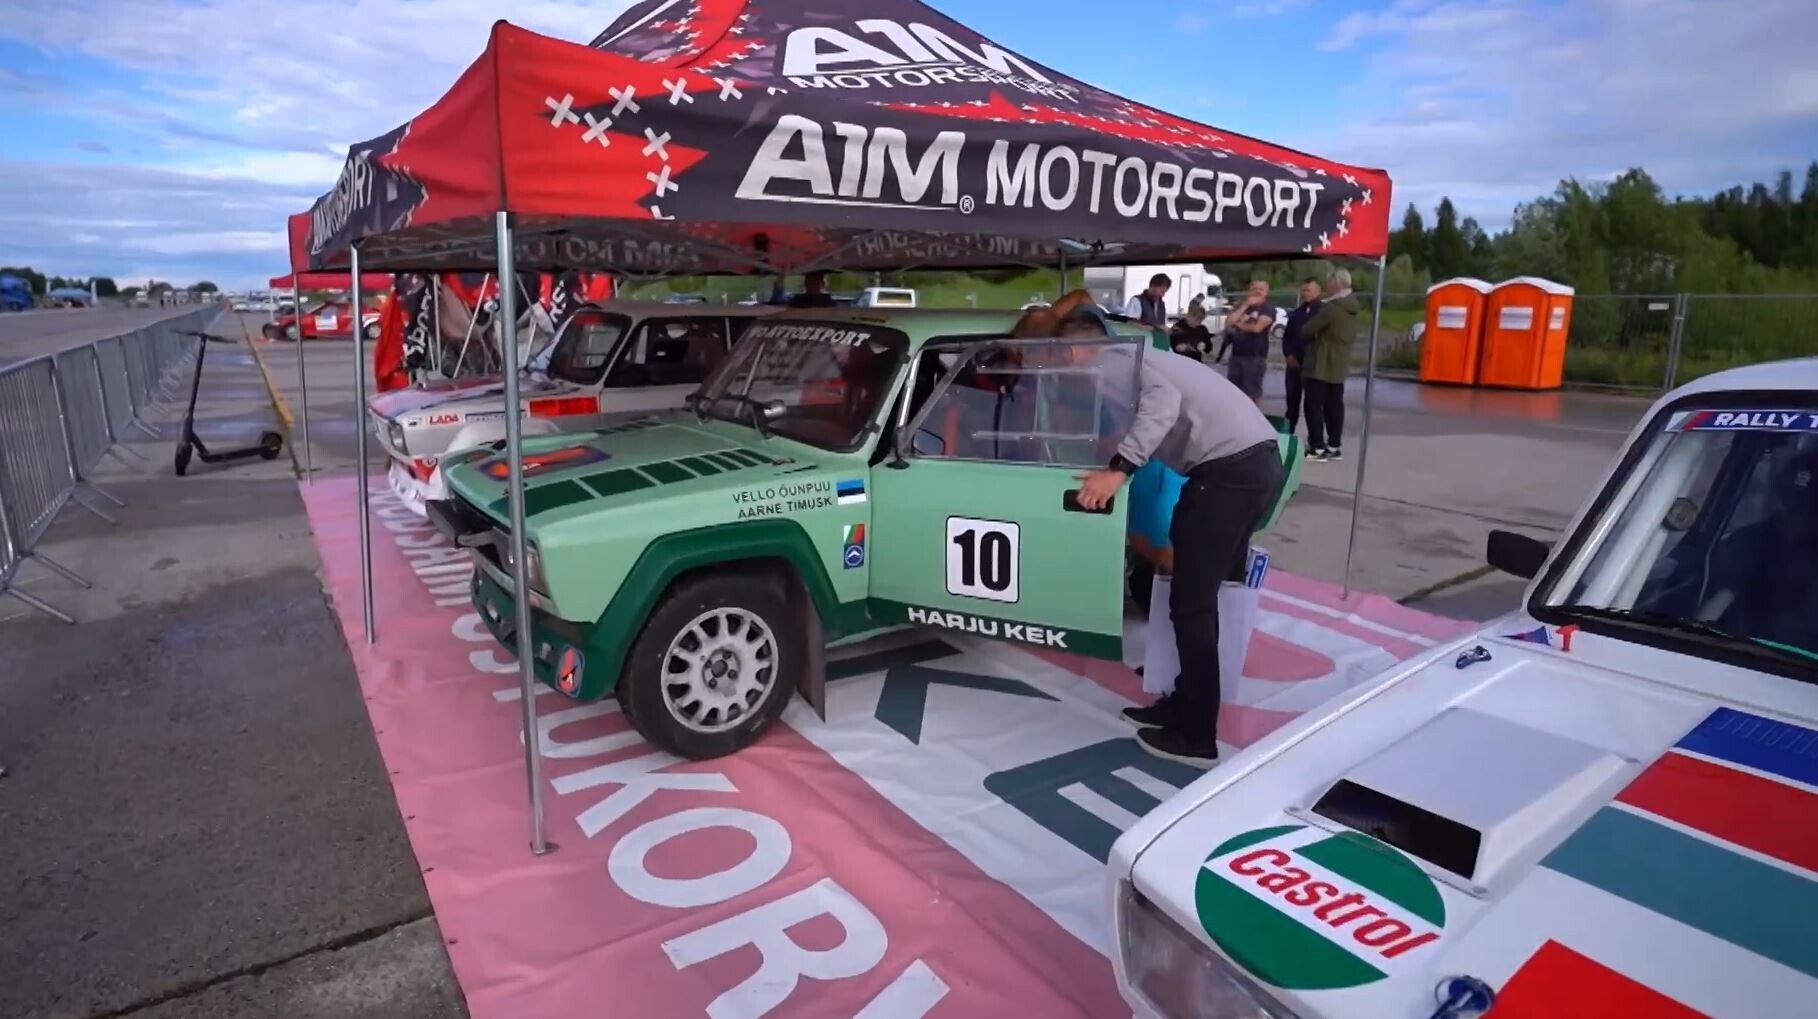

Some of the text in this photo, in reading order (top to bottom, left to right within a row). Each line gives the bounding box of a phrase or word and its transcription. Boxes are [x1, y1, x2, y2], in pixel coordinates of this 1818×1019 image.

[985, 139, 1325, 230] MOTORSPORT
[429, 414, 460, 426] LADA
[1713, 412, 1800, 428] RALLY
[732, 487, 776, 504] VELLO
[738, 496, 833, 519] AARNE TIMUSK
[953, 529, 1012, 592] 10
[907, 606, 1068, 649] HARJU KEK
[1228, 848, 1440, 959] Castrol
